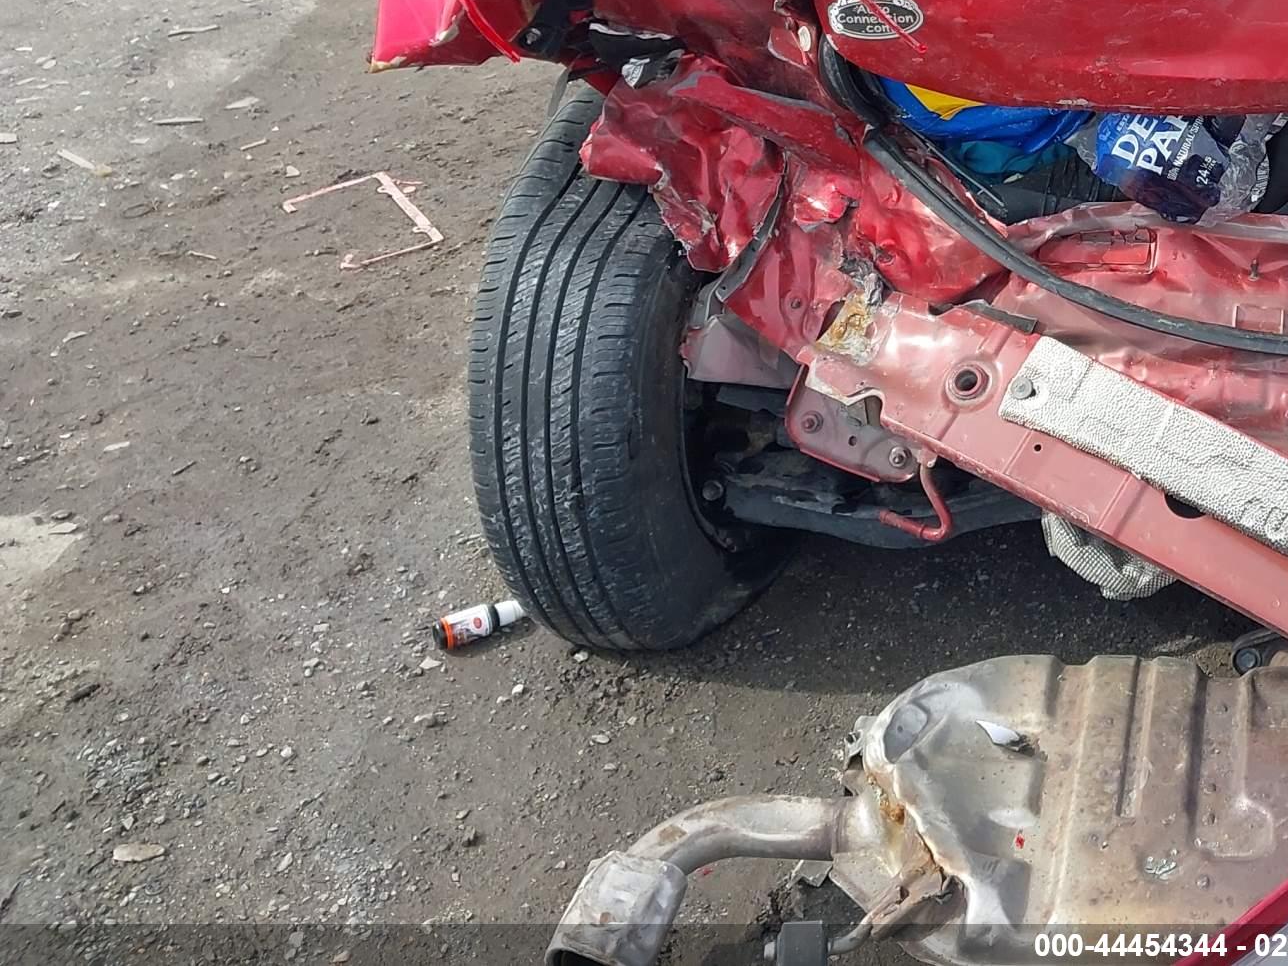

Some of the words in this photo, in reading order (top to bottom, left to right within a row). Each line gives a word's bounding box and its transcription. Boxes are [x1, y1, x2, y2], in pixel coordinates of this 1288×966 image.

[856, 5, 890, 14] Ao
[1111, 114, 1160, 169] DE
[1172, 132, 1198, 168] NATURAL
[1196, 169, 1209, 186] 24
